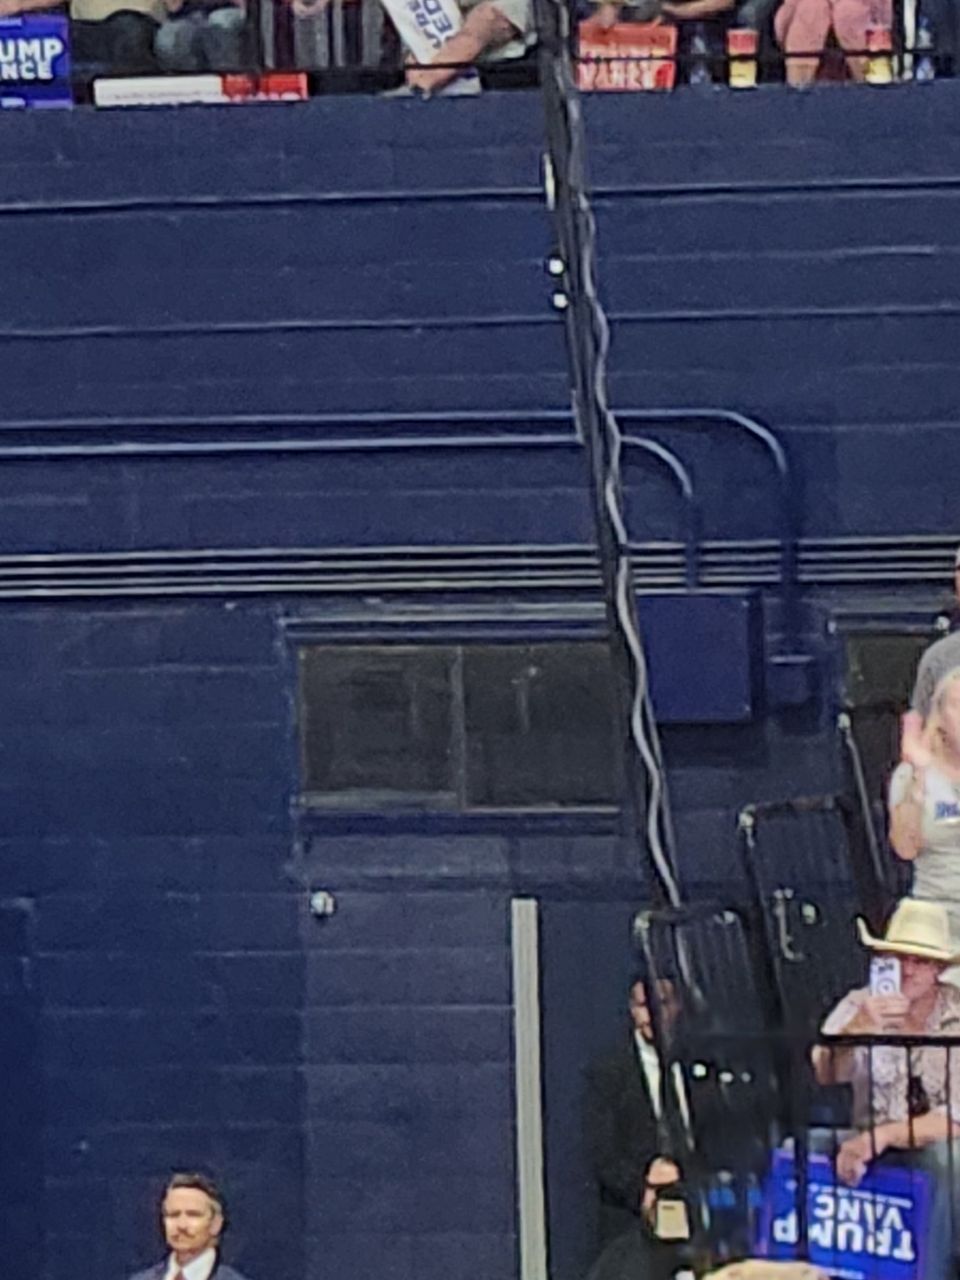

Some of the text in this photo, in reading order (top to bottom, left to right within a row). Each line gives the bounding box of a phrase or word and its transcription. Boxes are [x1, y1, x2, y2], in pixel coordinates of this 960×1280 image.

[0, 37, 64, 62] UMP
[0, 61, 53, 80] NCE
[812, 1193, 906, 1231] VANC
